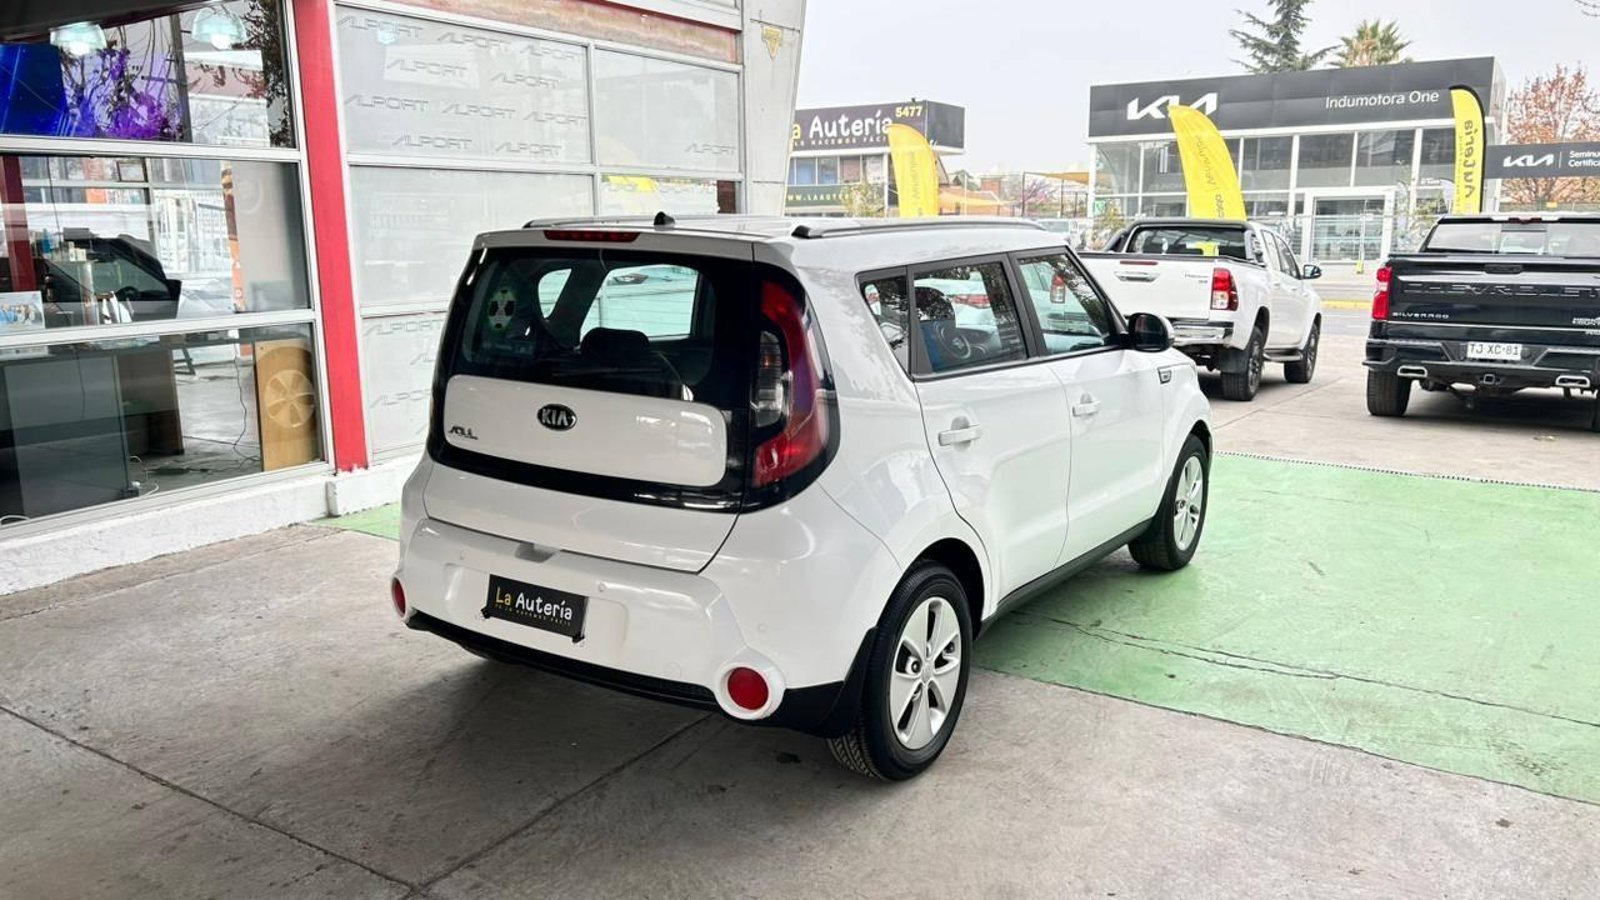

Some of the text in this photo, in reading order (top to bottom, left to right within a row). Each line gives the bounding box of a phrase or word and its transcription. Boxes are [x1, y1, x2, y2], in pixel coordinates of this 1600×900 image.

[1325, 90, 1440, 109] Indumotora One
[895, 105, 923, 118] 5477
[809, 109, 893, 140] Autería
[1503, 154, 1555, 167] KIA
[541, 408, 569, 427] KIA
[495, 586, 573, 620] La Autería
